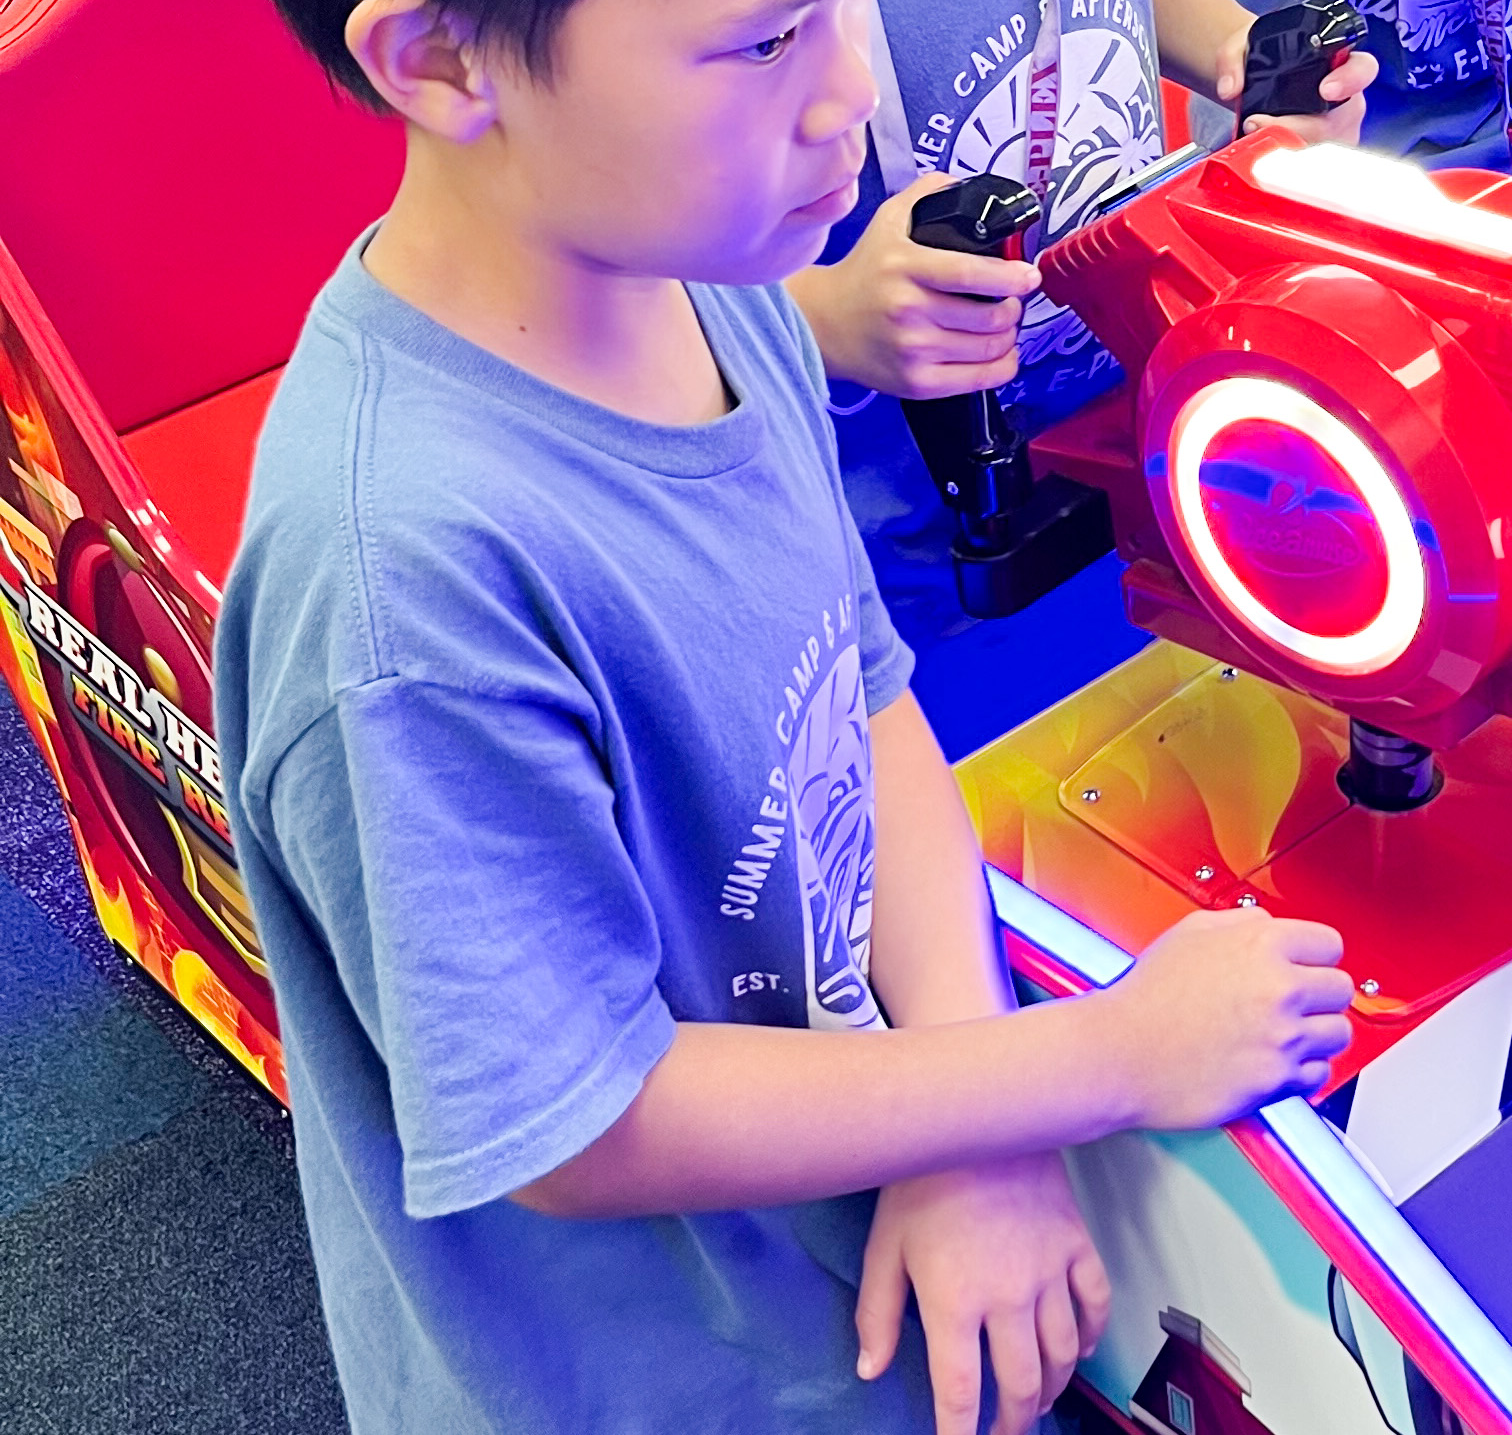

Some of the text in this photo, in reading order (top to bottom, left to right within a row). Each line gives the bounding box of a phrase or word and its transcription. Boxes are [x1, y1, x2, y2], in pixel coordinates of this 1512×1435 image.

[953, 13, 1027, 98] CAMP
[1026, 61, 1058, 203] E-PLEX
[24, 585, 152, 729] REAL
[775, 634, 821, 746] CAMP
[71, 675, 168, 785] FIRE
[731, 971, 790, 998] EST.
